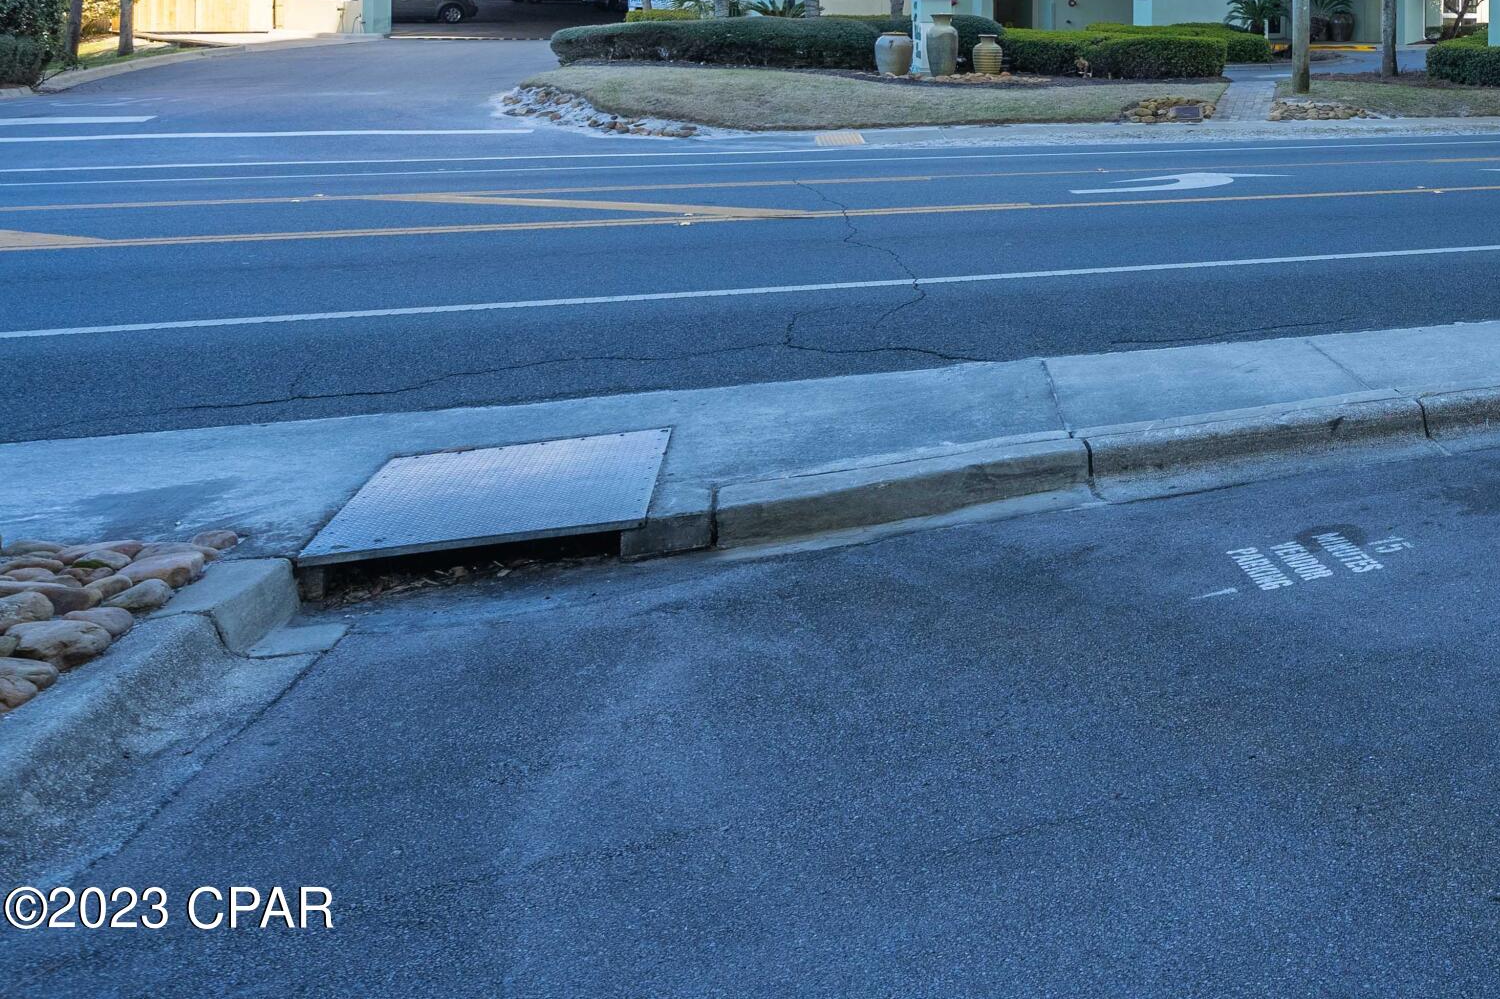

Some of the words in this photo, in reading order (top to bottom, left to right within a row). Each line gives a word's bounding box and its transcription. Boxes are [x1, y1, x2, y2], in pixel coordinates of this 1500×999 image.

[1226, 546, 1294, 591] PARKING
[1270, 541, 1334, 582] VENDOR
[1312, 531, 1384, 573] MINUTES
